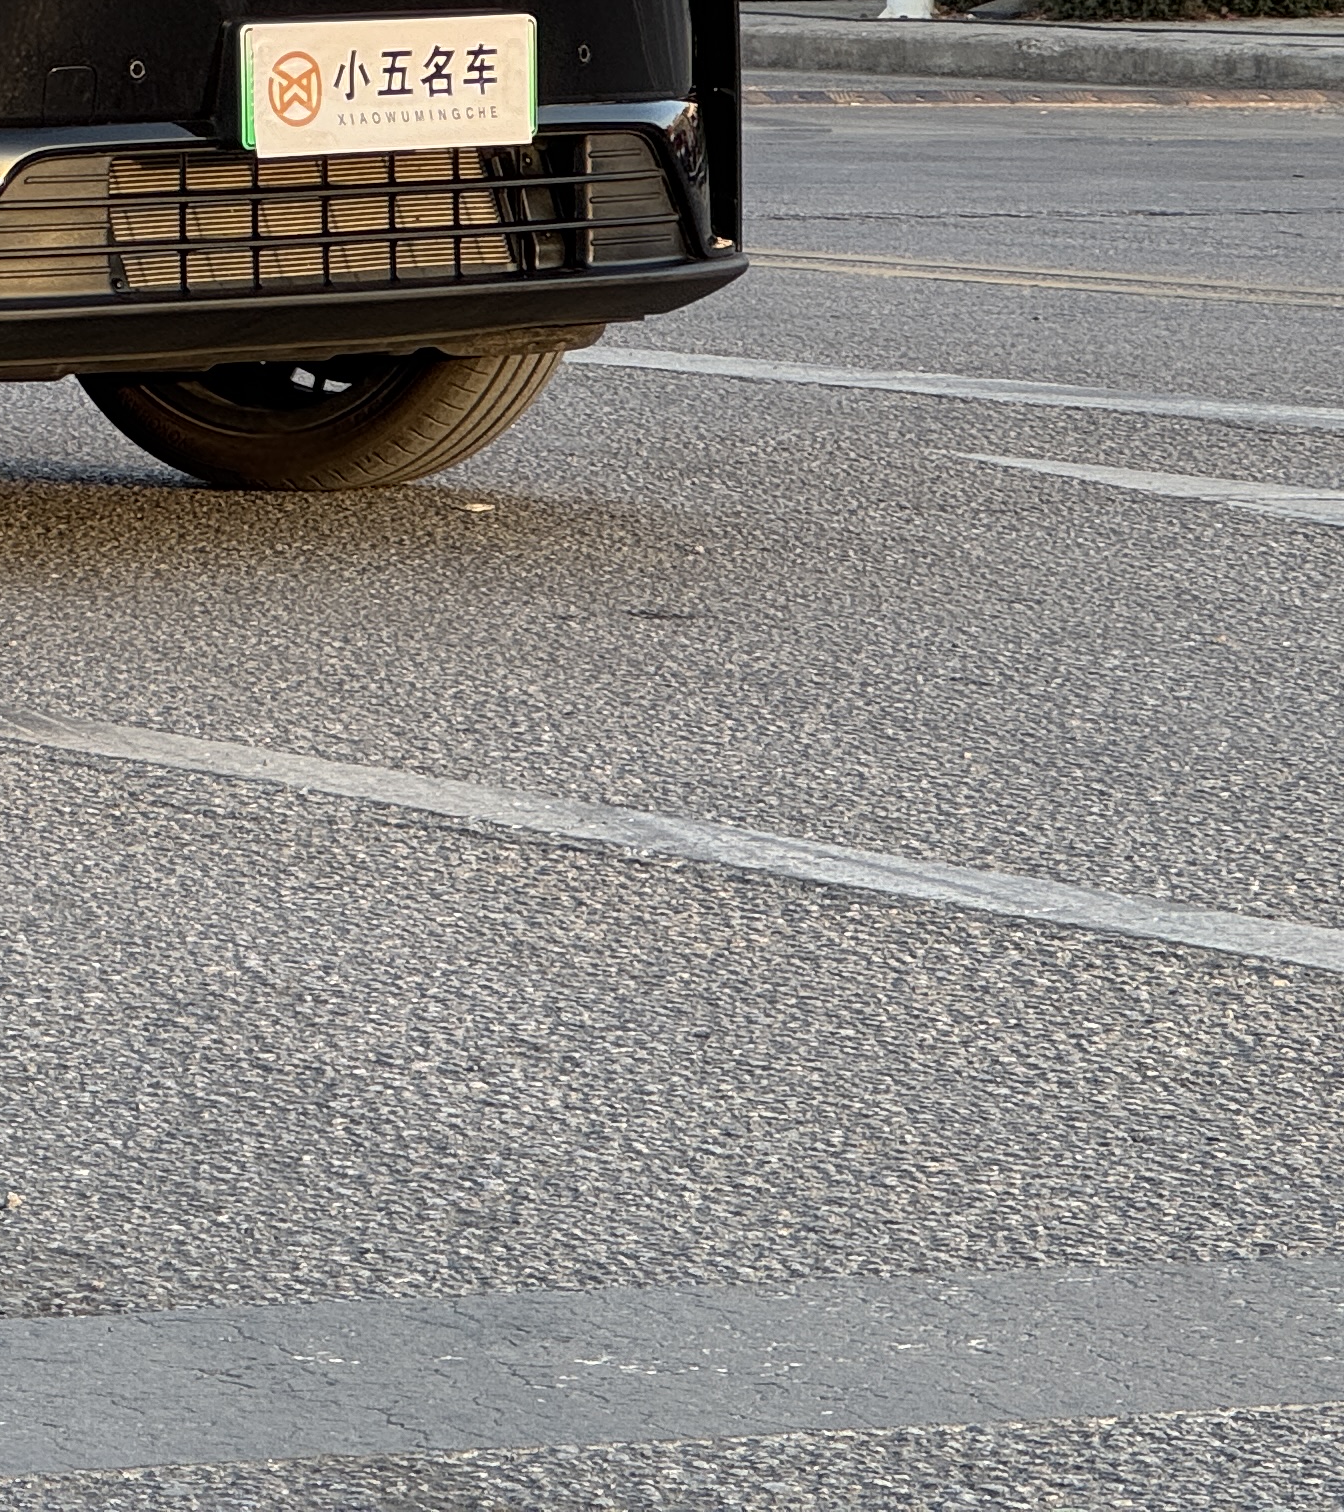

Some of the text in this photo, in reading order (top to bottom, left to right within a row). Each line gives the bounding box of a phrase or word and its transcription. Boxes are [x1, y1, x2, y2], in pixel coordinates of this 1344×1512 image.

[333, 44, 498, 100] 小五名车
[337, 105, 499, 126] XIAOWUMINGCHE
